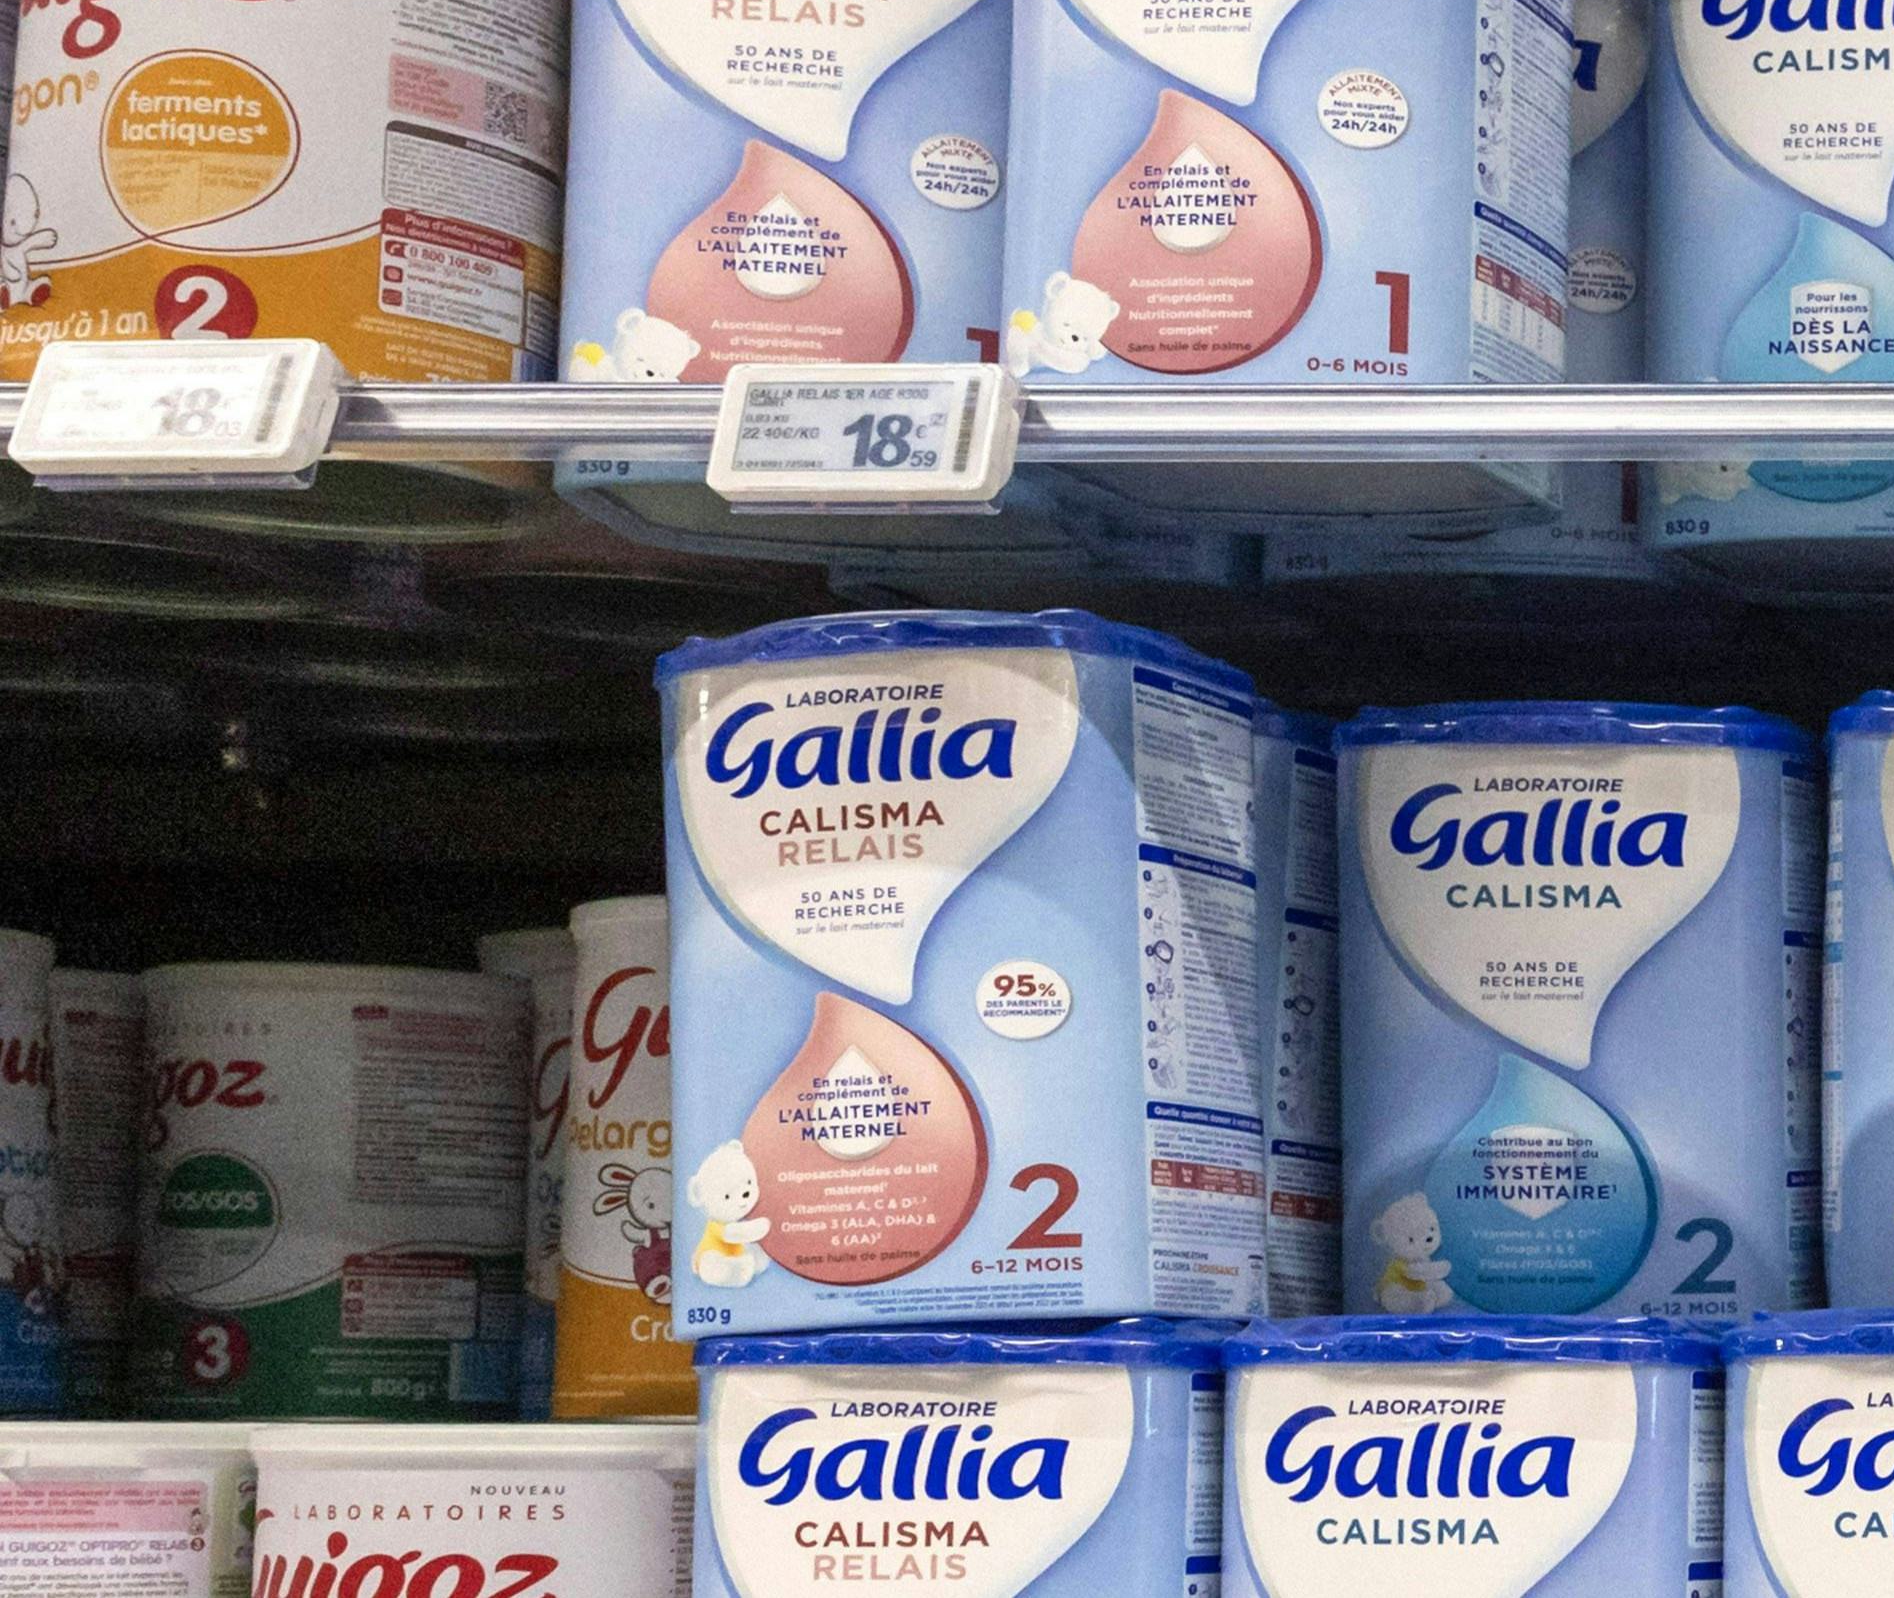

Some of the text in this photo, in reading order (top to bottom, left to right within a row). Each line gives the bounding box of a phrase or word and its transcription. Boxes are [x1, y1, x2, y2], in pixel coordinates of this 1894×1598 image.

[127, 94, 263, 118] ferments
[170, 276, 229, 340] 2
[843, 414, 937, 468] 18 59
[785, 684, 944, 708] LABORATOIRE
[705, 702, 1017, 799] Gallia
[1390, 783, 1688, 871] Gallia
[993, 974, 1057, 998] 95%
[470, 1485, 567, 1496] NOUVEAU
